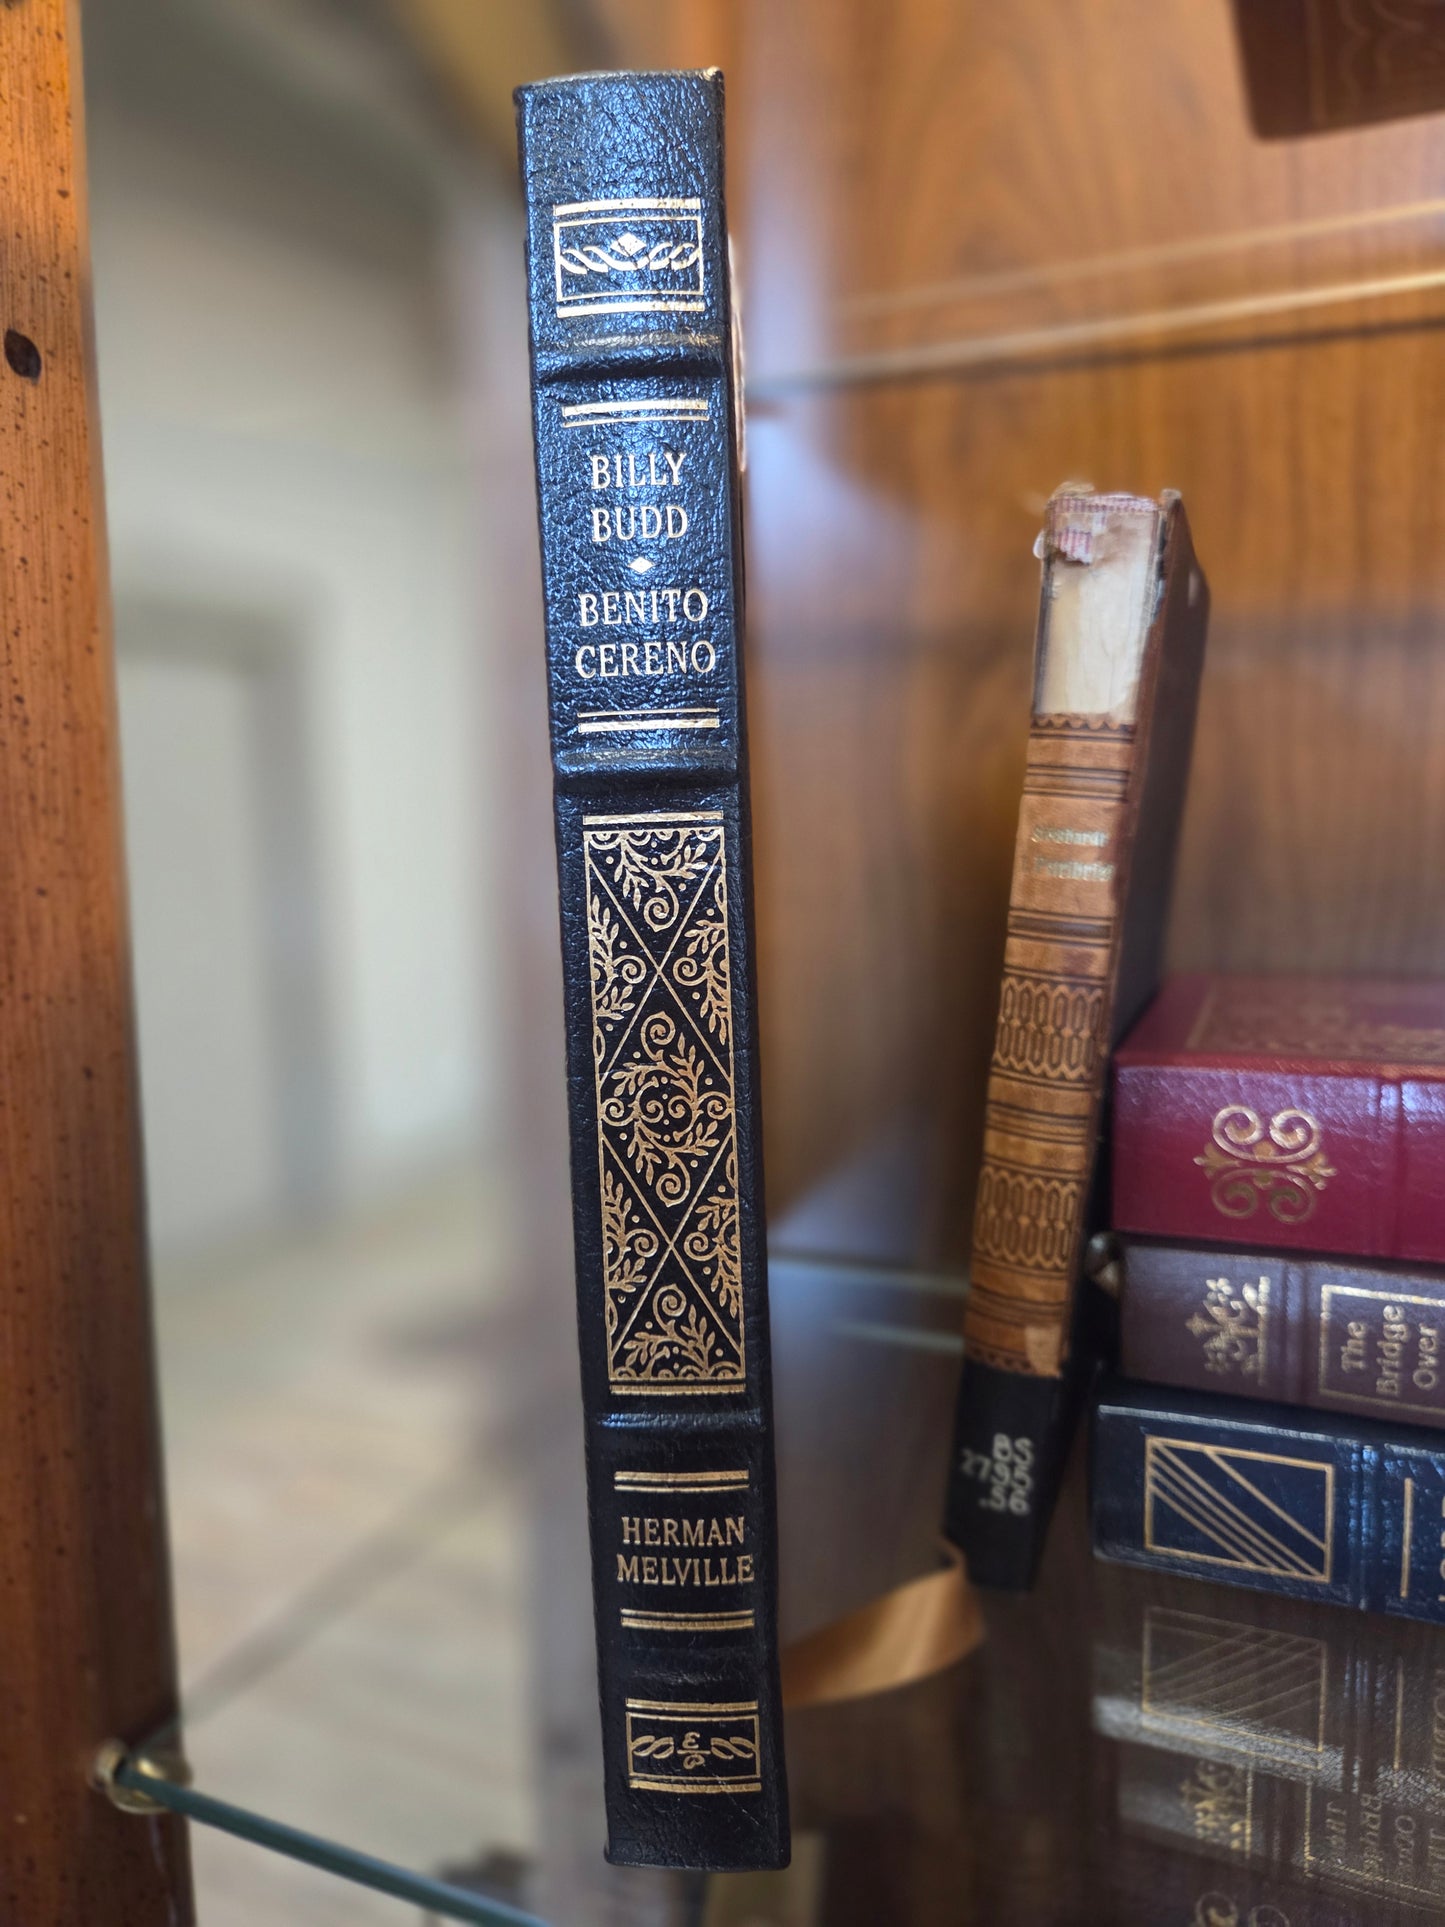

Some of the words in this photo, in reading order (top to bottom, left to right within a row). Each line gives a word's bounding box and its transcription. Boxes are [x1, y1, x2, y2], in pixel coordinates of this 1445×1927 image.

[591, 452, 686, 490] BILLY
[591, 505, 689, 542] BUDD
[579, 588, 709, 627] BENITO
[574, 641, 717, 679] CERENO
[1340, 1321, 1367, 1373] The
[1375, 1304, 1410, 1396] Bridge
[1412, 1322, 1438, 1390] Over
[621, 1516, 745, 1547] HERMAN
[616, 1553, 754, 1586] MELVILLE
